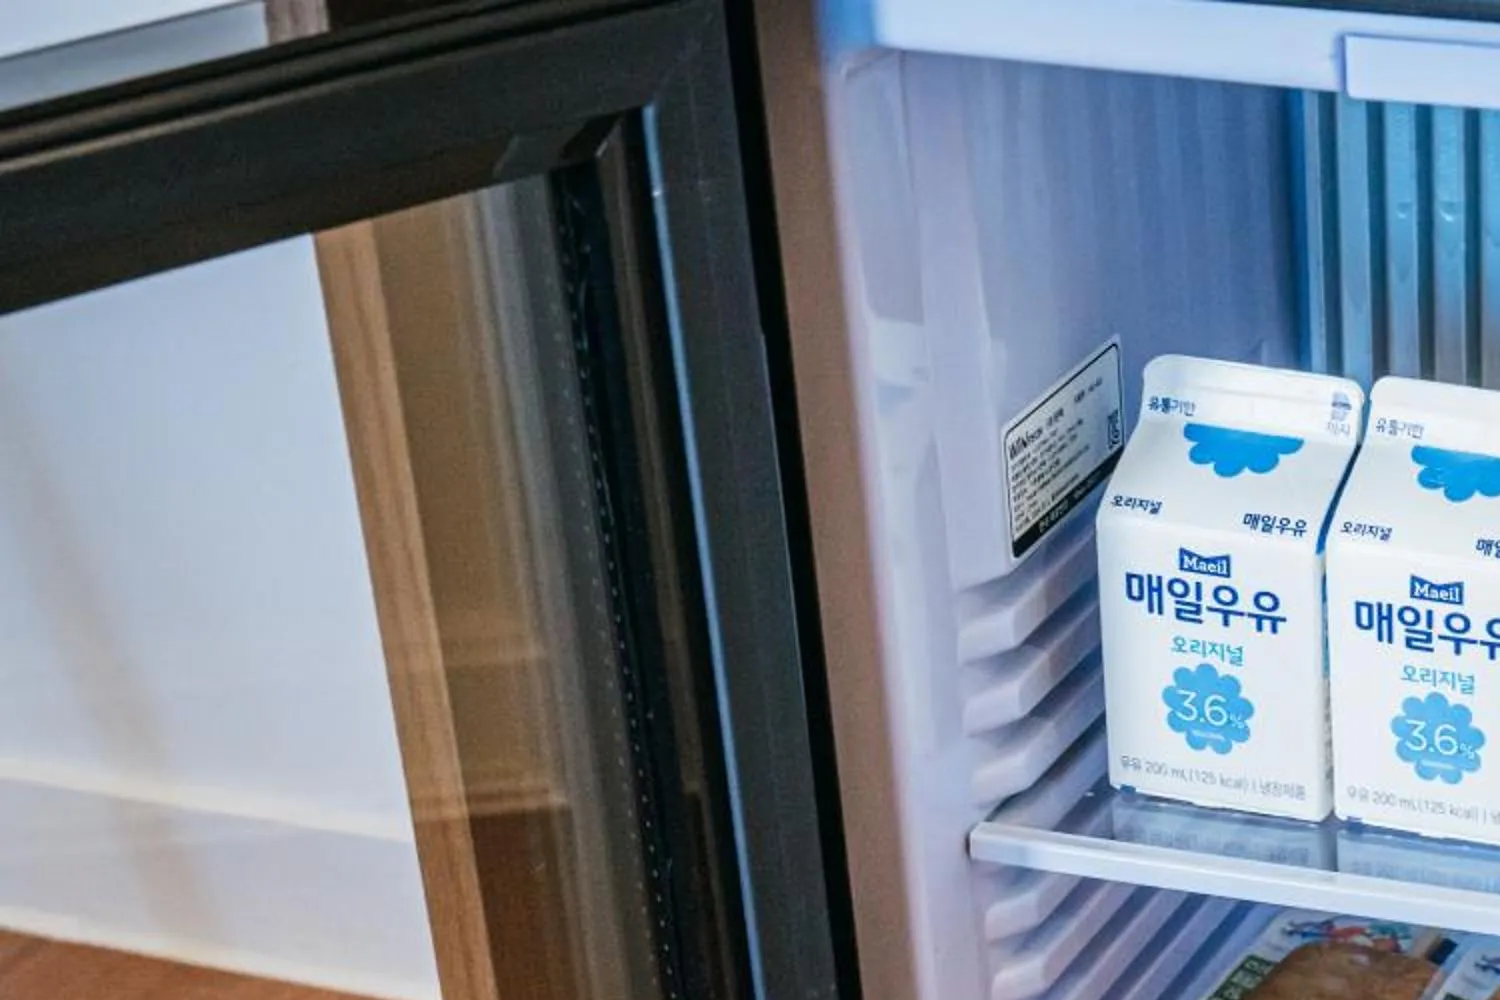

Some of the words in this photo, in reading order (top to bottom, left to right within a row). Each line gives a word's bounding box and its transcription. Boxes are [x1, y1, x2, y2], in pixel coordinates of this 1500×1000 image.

[1111, 495, 1163, 515] 오리지널
[1242, 512, 1308, 537] 매일우유
[1339, 521, 1393, 542] 오리지널
[1182, 554, 1228, 575] Maeil
[1124, 571, 1288, 635] 매일우유
[1412, 581, 1461, 603] Maeil
[1171, 635, 1245, 667] 오리지널
[1400, 664, 1476, 695] 오리지널
[1175, 689, 1246, 730] 3.6%
[1405, 719, 1476, 760] 3.6%
